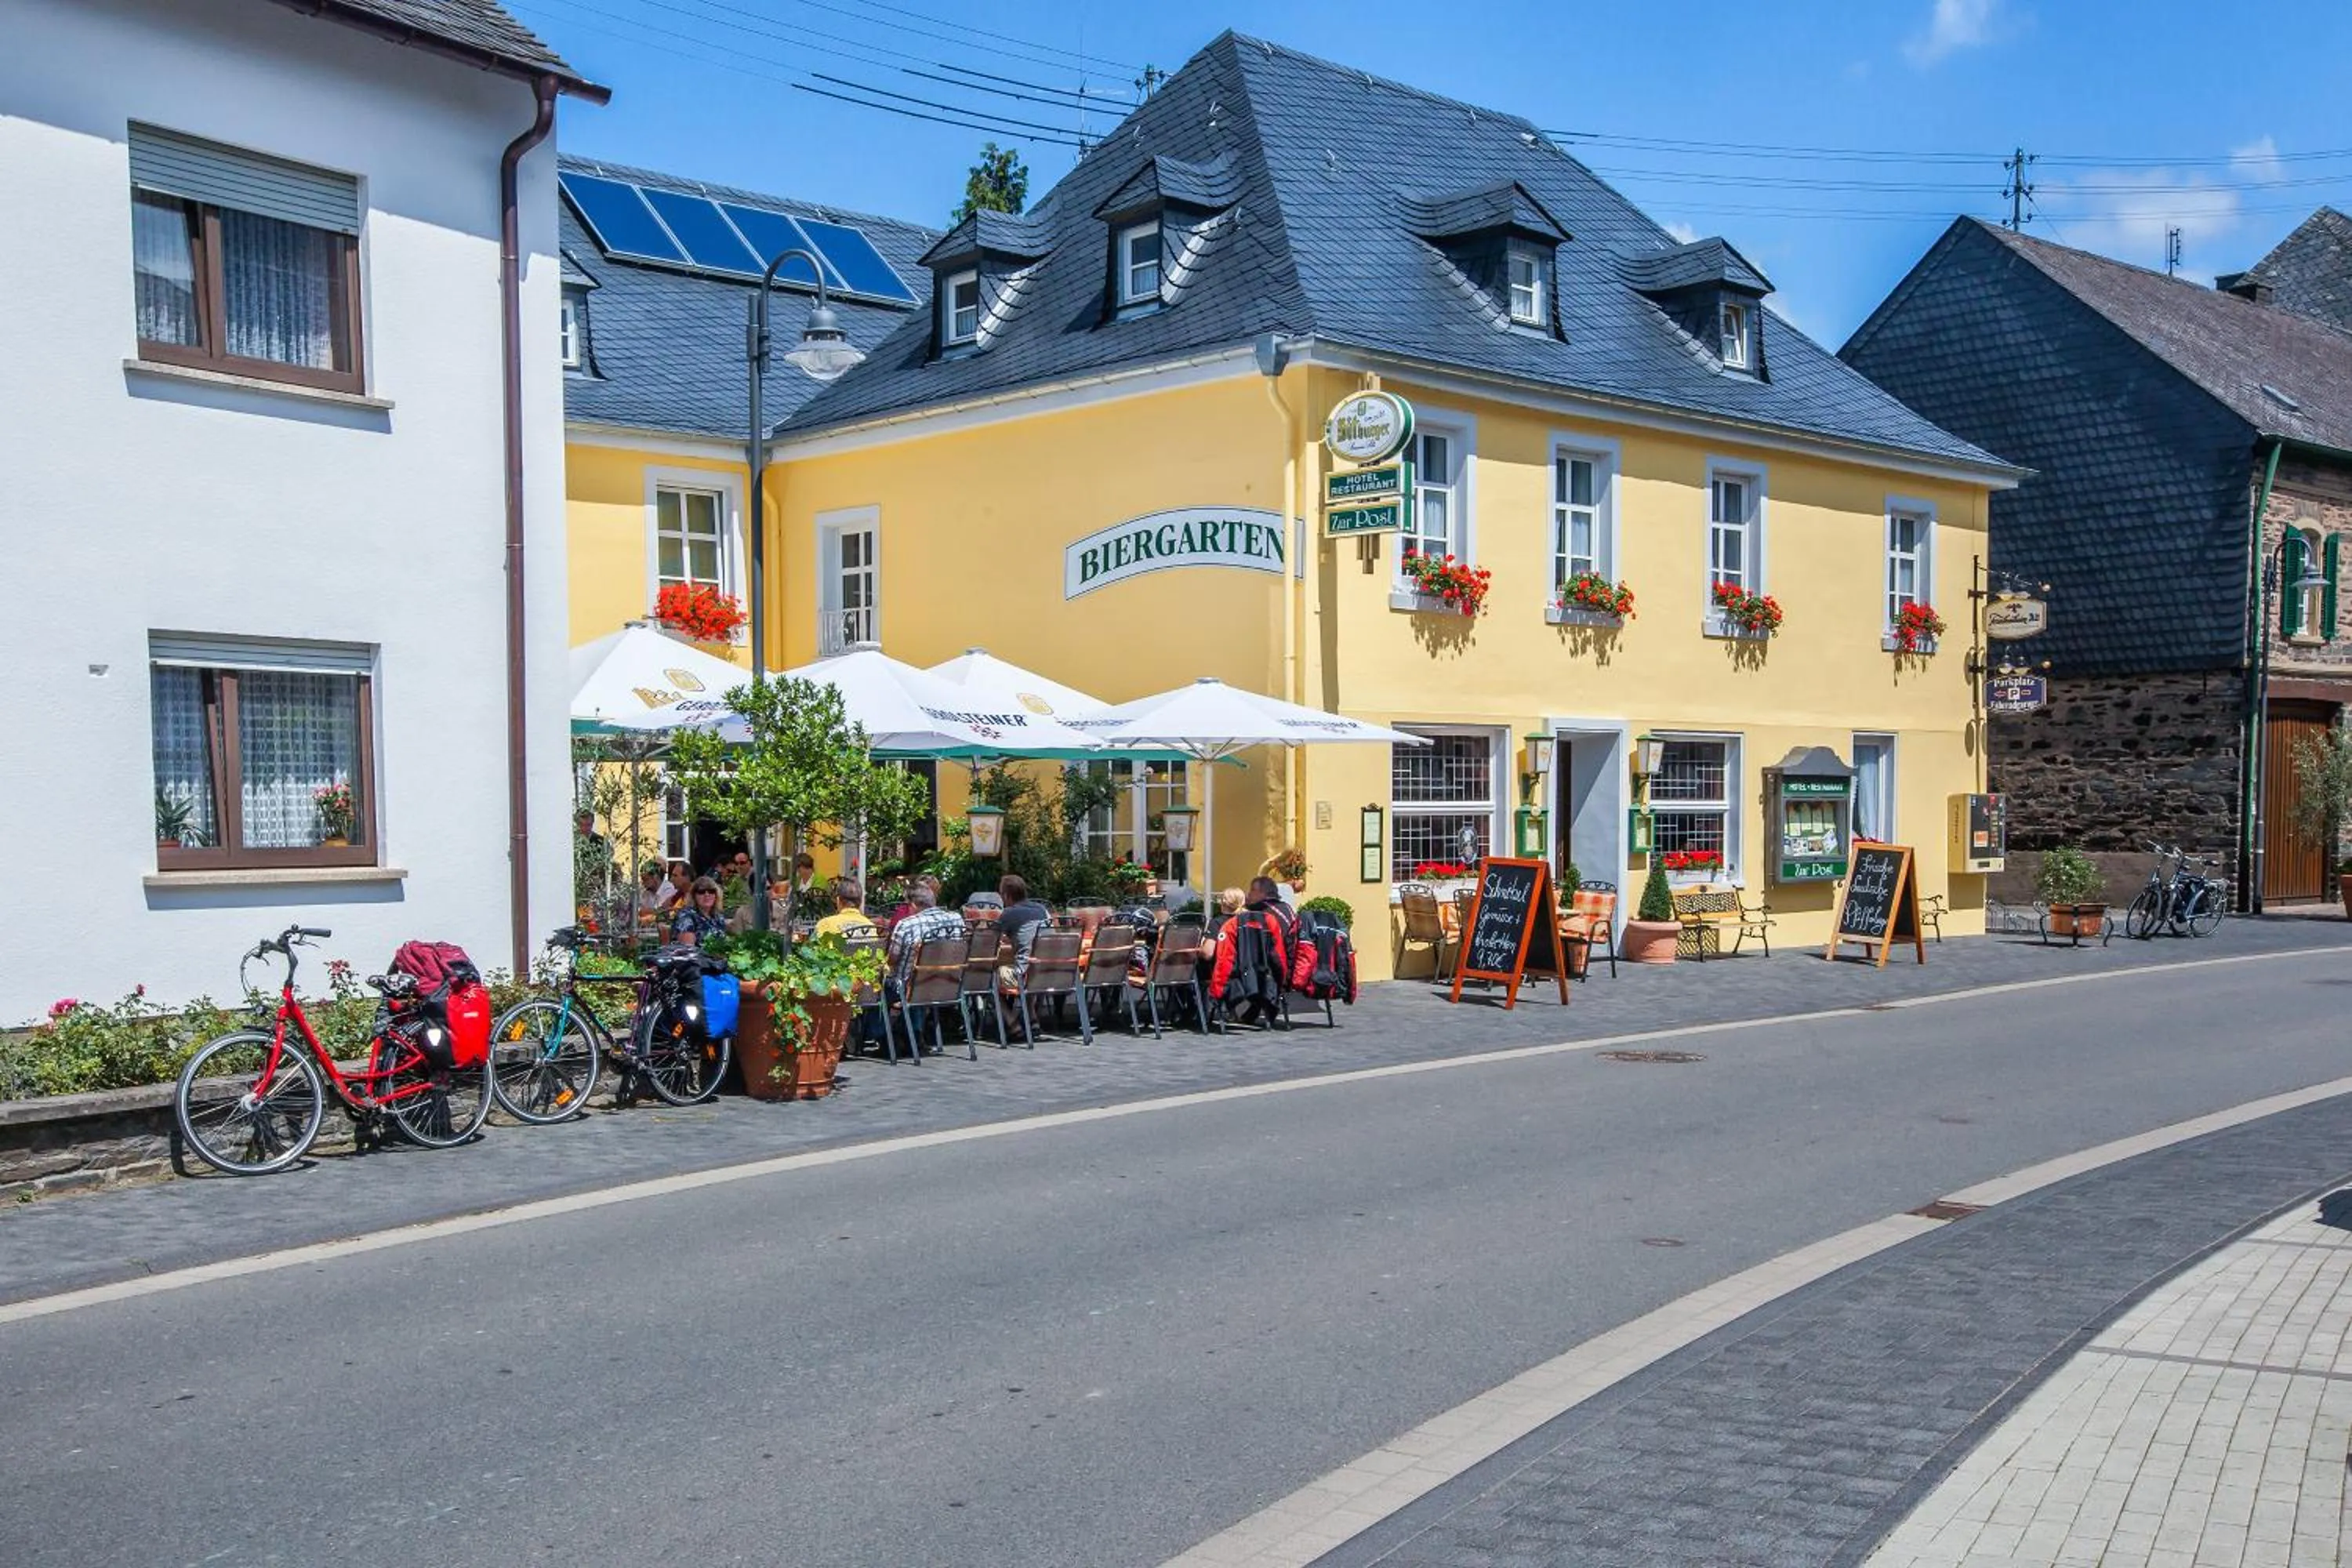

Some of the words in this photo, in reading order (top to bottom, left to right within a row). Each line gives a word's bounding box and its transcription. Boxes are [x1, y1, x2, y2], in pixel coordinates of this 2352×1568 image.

[1346, 473, 1379, 484] HOTEL
[1330, 479, 1396, 495] RESTAURANT
[1330, 514, 1352, 531] Zur
[1354, 510, 1396, 528] Post
[1078, 519, 1285, 584] BIERGARTEN
[1994, 677, 2035, 688] Parkplatz
[1795, 863, 1809, 877] Zur
